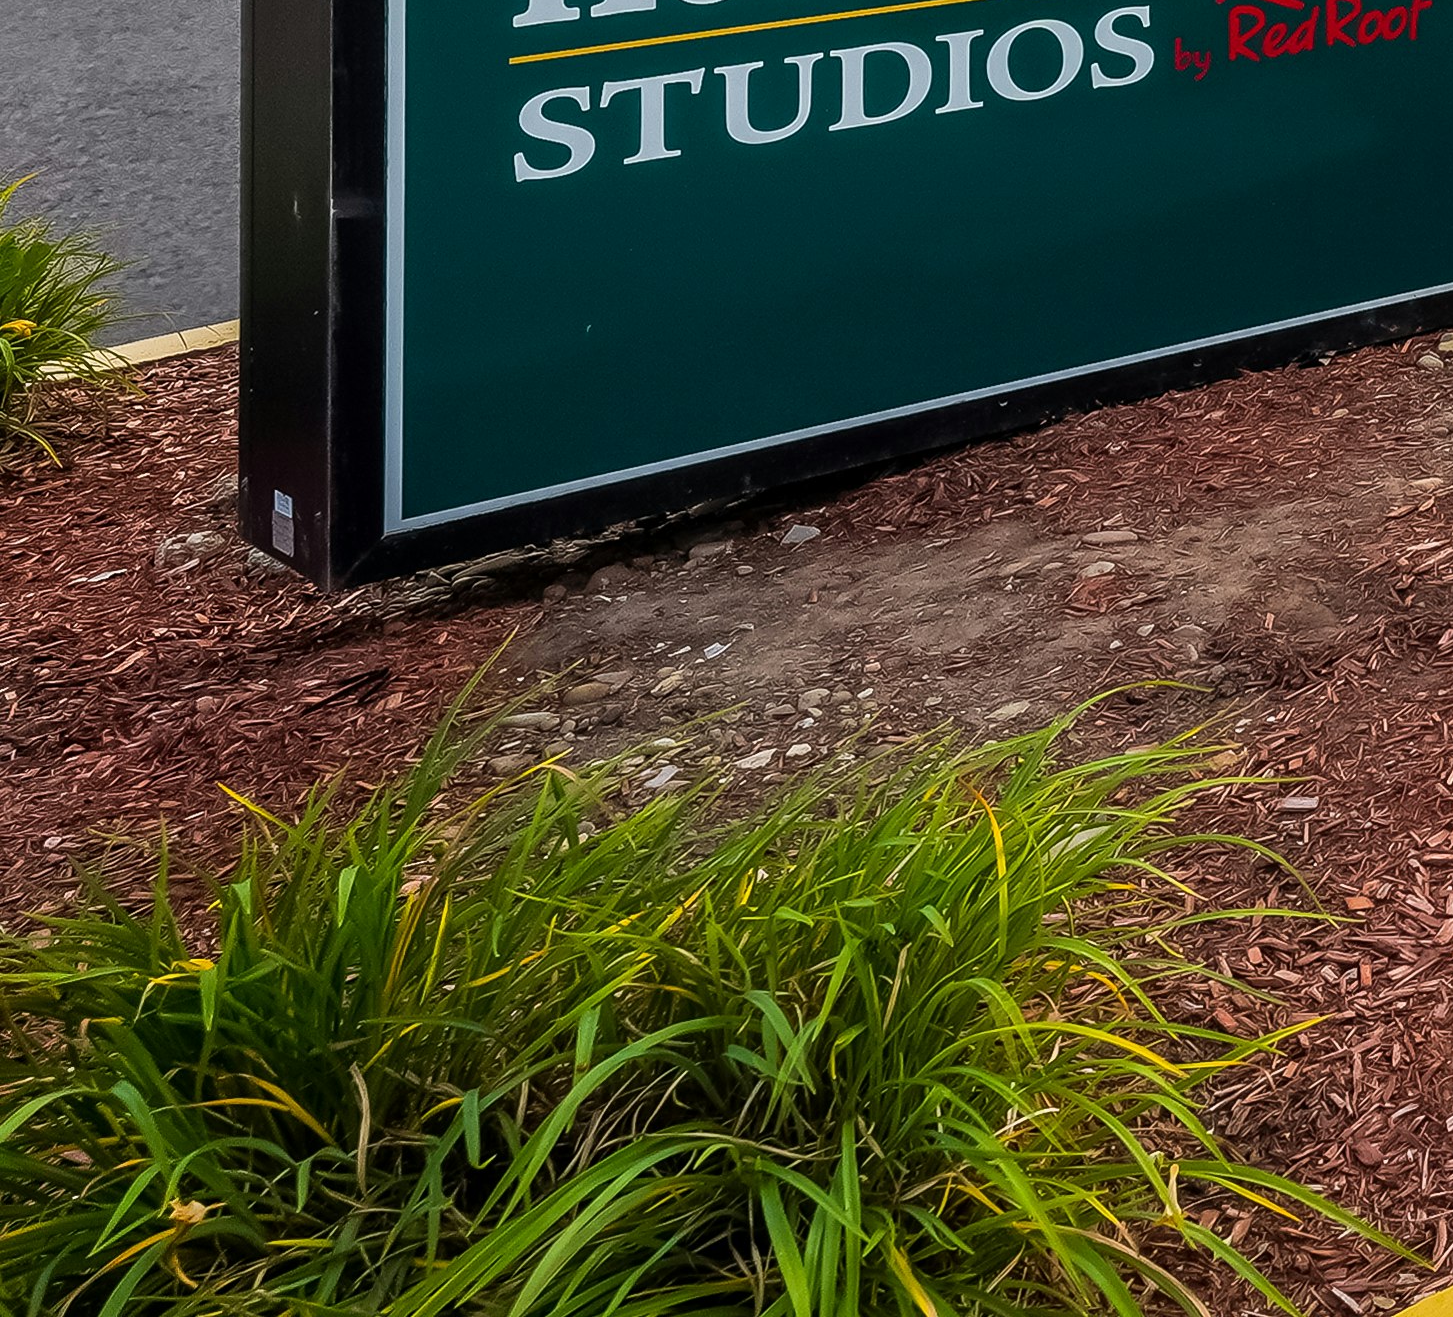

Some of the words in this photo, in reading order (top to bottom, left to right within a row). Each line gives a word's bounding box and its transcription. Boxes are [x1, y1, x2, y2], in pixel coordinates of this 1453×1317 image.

[514, 5, 1154, 183] STUDIOS
[1174, 37, 1212, 81] by
[1227, 4, 1321, 62] Red
